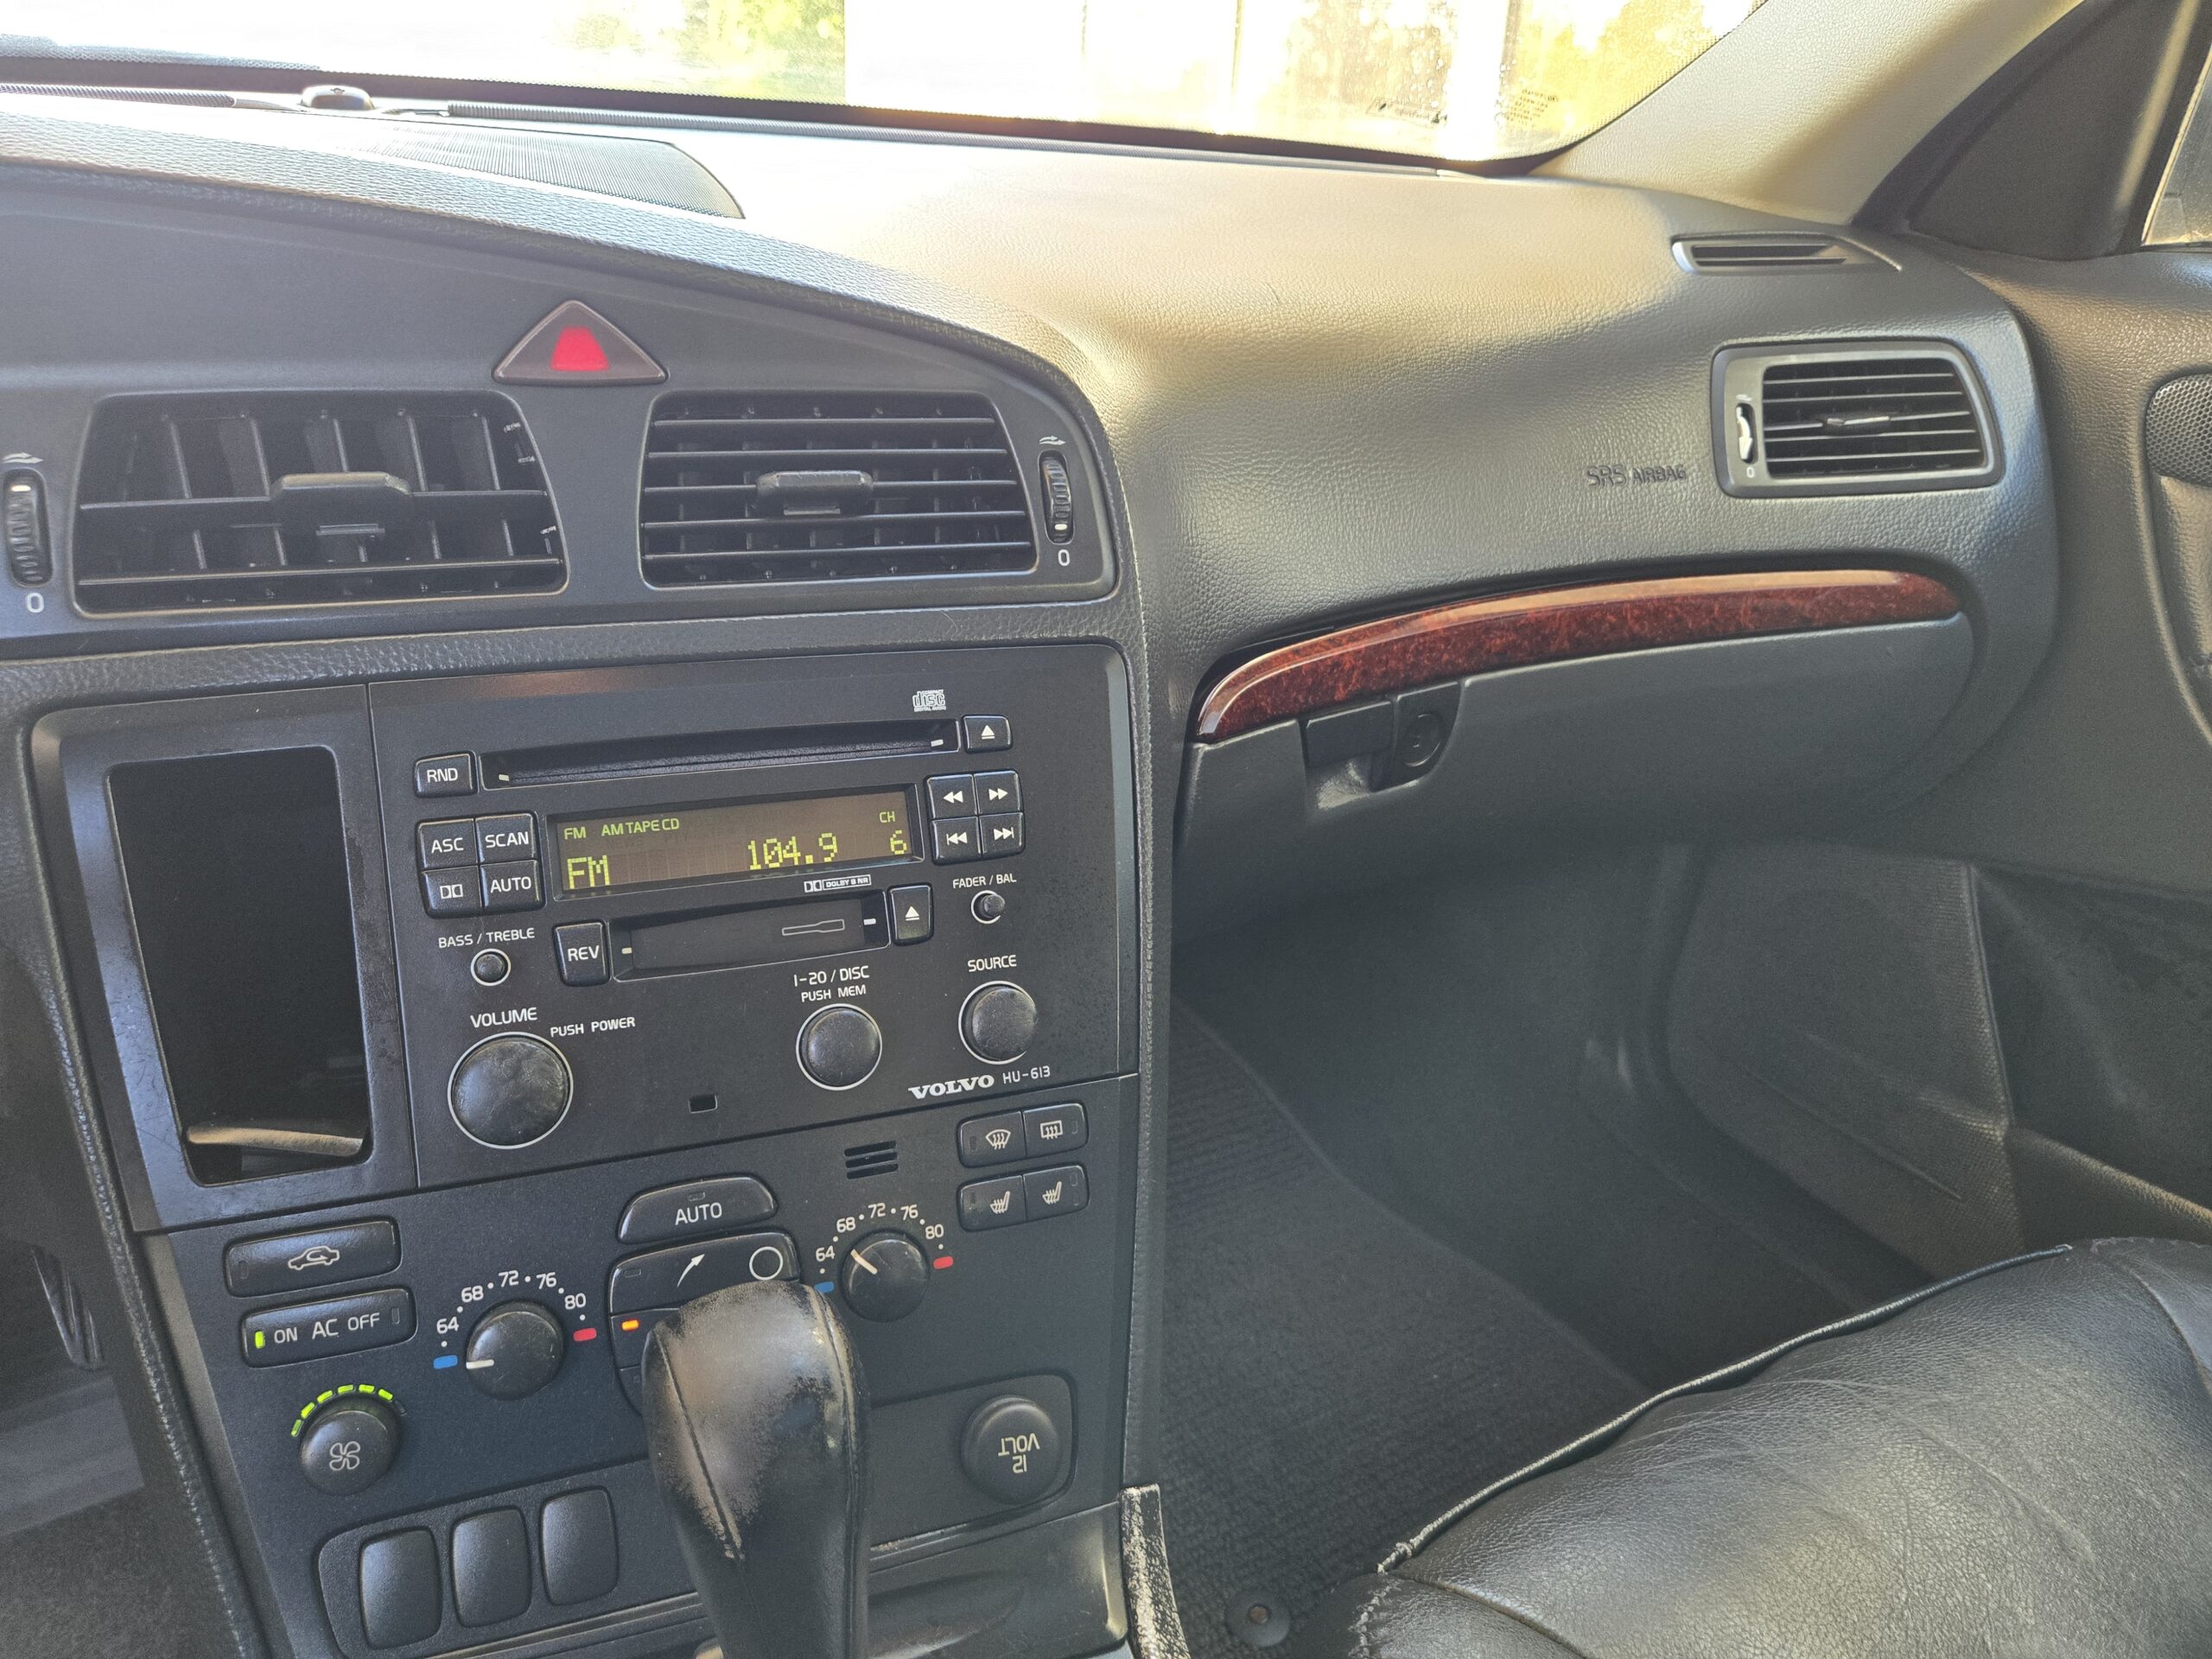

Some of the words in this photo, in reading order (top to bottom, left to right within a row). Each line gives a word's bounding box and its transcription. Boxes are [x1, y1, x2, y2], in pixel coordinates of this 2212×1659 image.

[1586, 464, 1626, 486] SRS
[1632, 463, 1687, 485] AIRBAG
[1058, 549, 1071, 567] 0
[26, 593, 43, 613] 0
[426, 767, 458, 783] RND
[879, 810, 896, 823] CH
[485, 831, 530, 848] SCAN
[564, 826, 587, 840] FM
[601, 823, 624, 836] AM
[626, 820, 660, 834] TAPE
[662, 818, 680, 830] CD
[431, 837, 464, 854] ASC
[747, 832, 838, 870] 104.9
[889, 830, 907, 855] 6
[567, 855, 610, 889] FM
[953, 876, 986, 889] FADER
[996, 873, 1017, 885] BAL
[490, 876, 531, 893] AUTO
[438, 934, 473, 949] BASS
[486, 927, 536, 943] TREBLE
[567, 945, 600, 962] REV
[967, 954, 1017, 973] SOURCE
[840, 965, 870, 982] DISC
[801, 988, 831, 1003] PUSH
[838, 984, 867, 998] MEM
[470, 1007, 538, 1028] VOLUME
[550, 1023, 584, 1038] PUSH
[591, 1016, 636, 1033] POWER
[907, 1074, 995, 1099] VOLVO
[1002, 1065, 1051, 1084] HU-613
[675, 1202, 722, 1225] AUTO
[816, 1245, 836, 1262] 64
[836, 1217, 856, 1233] 68
[868, 1203, 886, 1218] 72
[900, 1205, 918, 1221] 76
[925, 1224, 944, 1240] 80
[436, 1317, 459, 1333] 64
[461, 1285, 484, 1303] 68
[499, 1270, 519, 1287] 72
[536, 1271, 557, 1288] 76
[564, 1292, 587, 1310] 80
[273, 1326, 298, 1344] ON
[312, 1319, 339, 1339] AC
[347, 1313, 380, 1332] OFF
[997, 1432, 1040, 1457] VOLT
